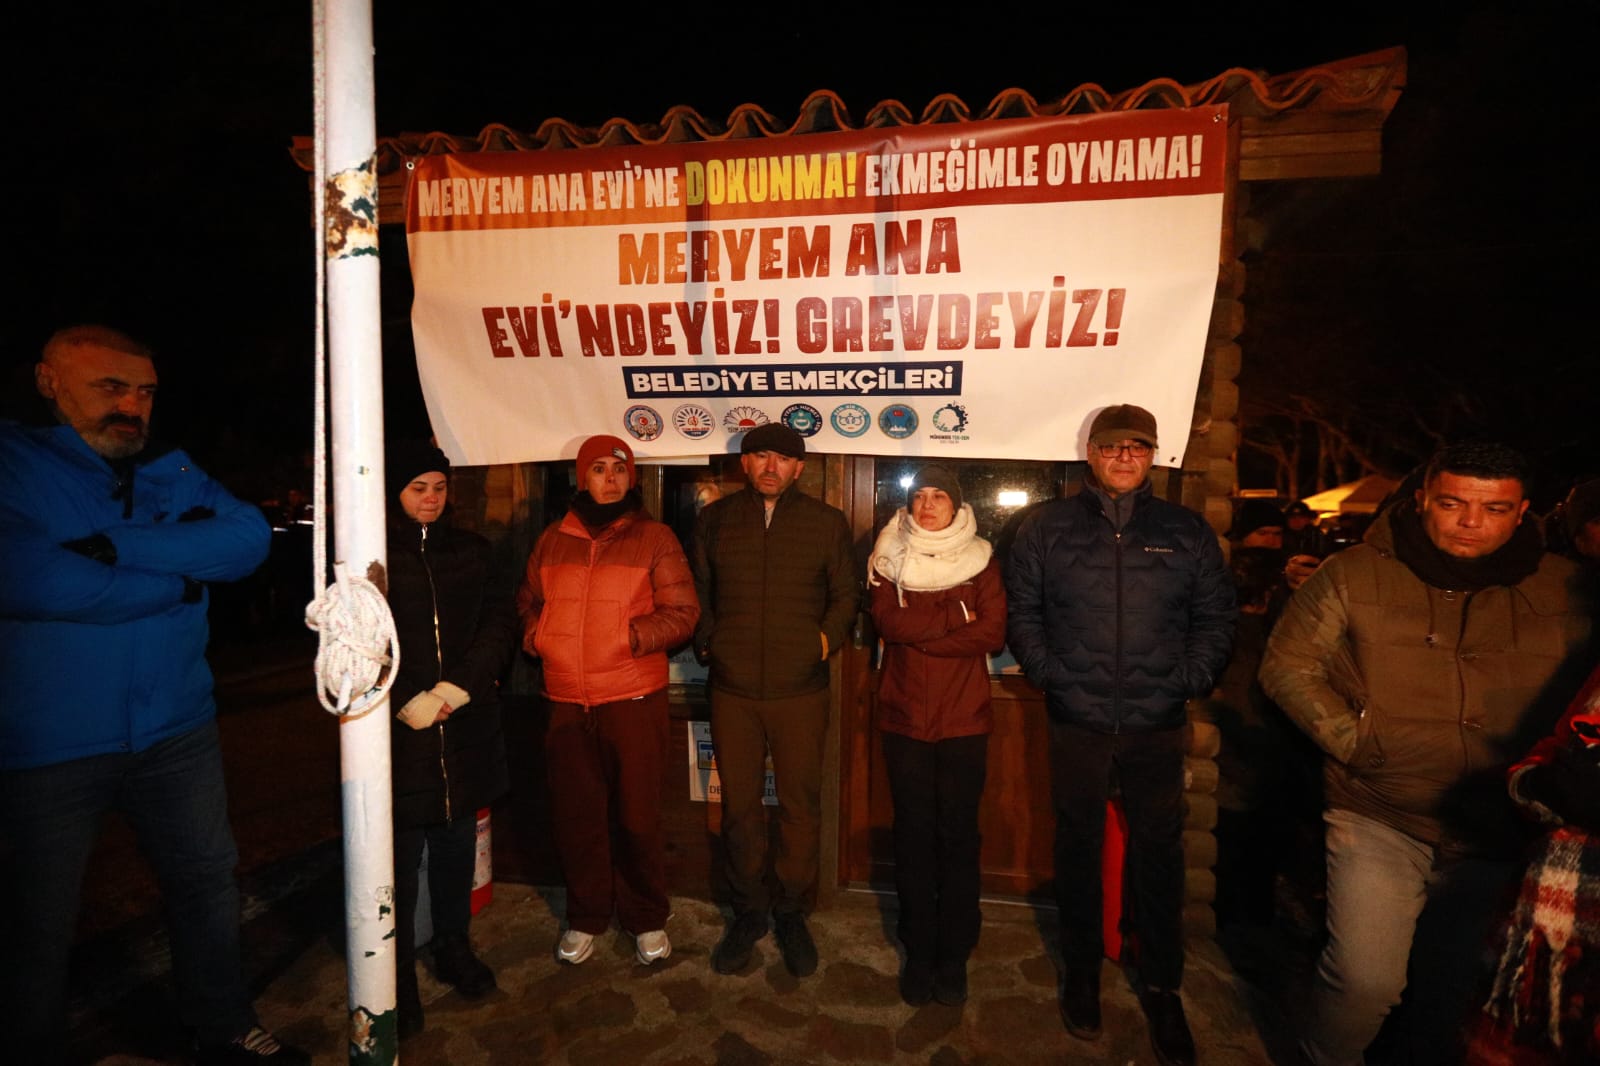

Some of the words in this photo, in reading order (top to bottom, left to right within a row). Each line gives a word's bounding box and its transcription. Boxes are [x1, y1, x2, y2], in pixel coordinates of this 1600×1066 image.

[418, 176, 525, 217] MERYEM
[531, 171, 586, 213] ANA
[592, 160, 680, 210] EVİ'NE
[685, 152, 857, 206] DOKUNMA!
[865, 138, 1040, 197] EKMEĞİMLE
[1046, 134, 1203, 187] OYNAMA!
[618, 225, 831, 285] MERYEM
[845, 216, 961, 277] ANA
[482, 287, 781, 358] EVİ'NDEYİZ!
[796, 275, 1126, 354] GREVDEYİZ!
